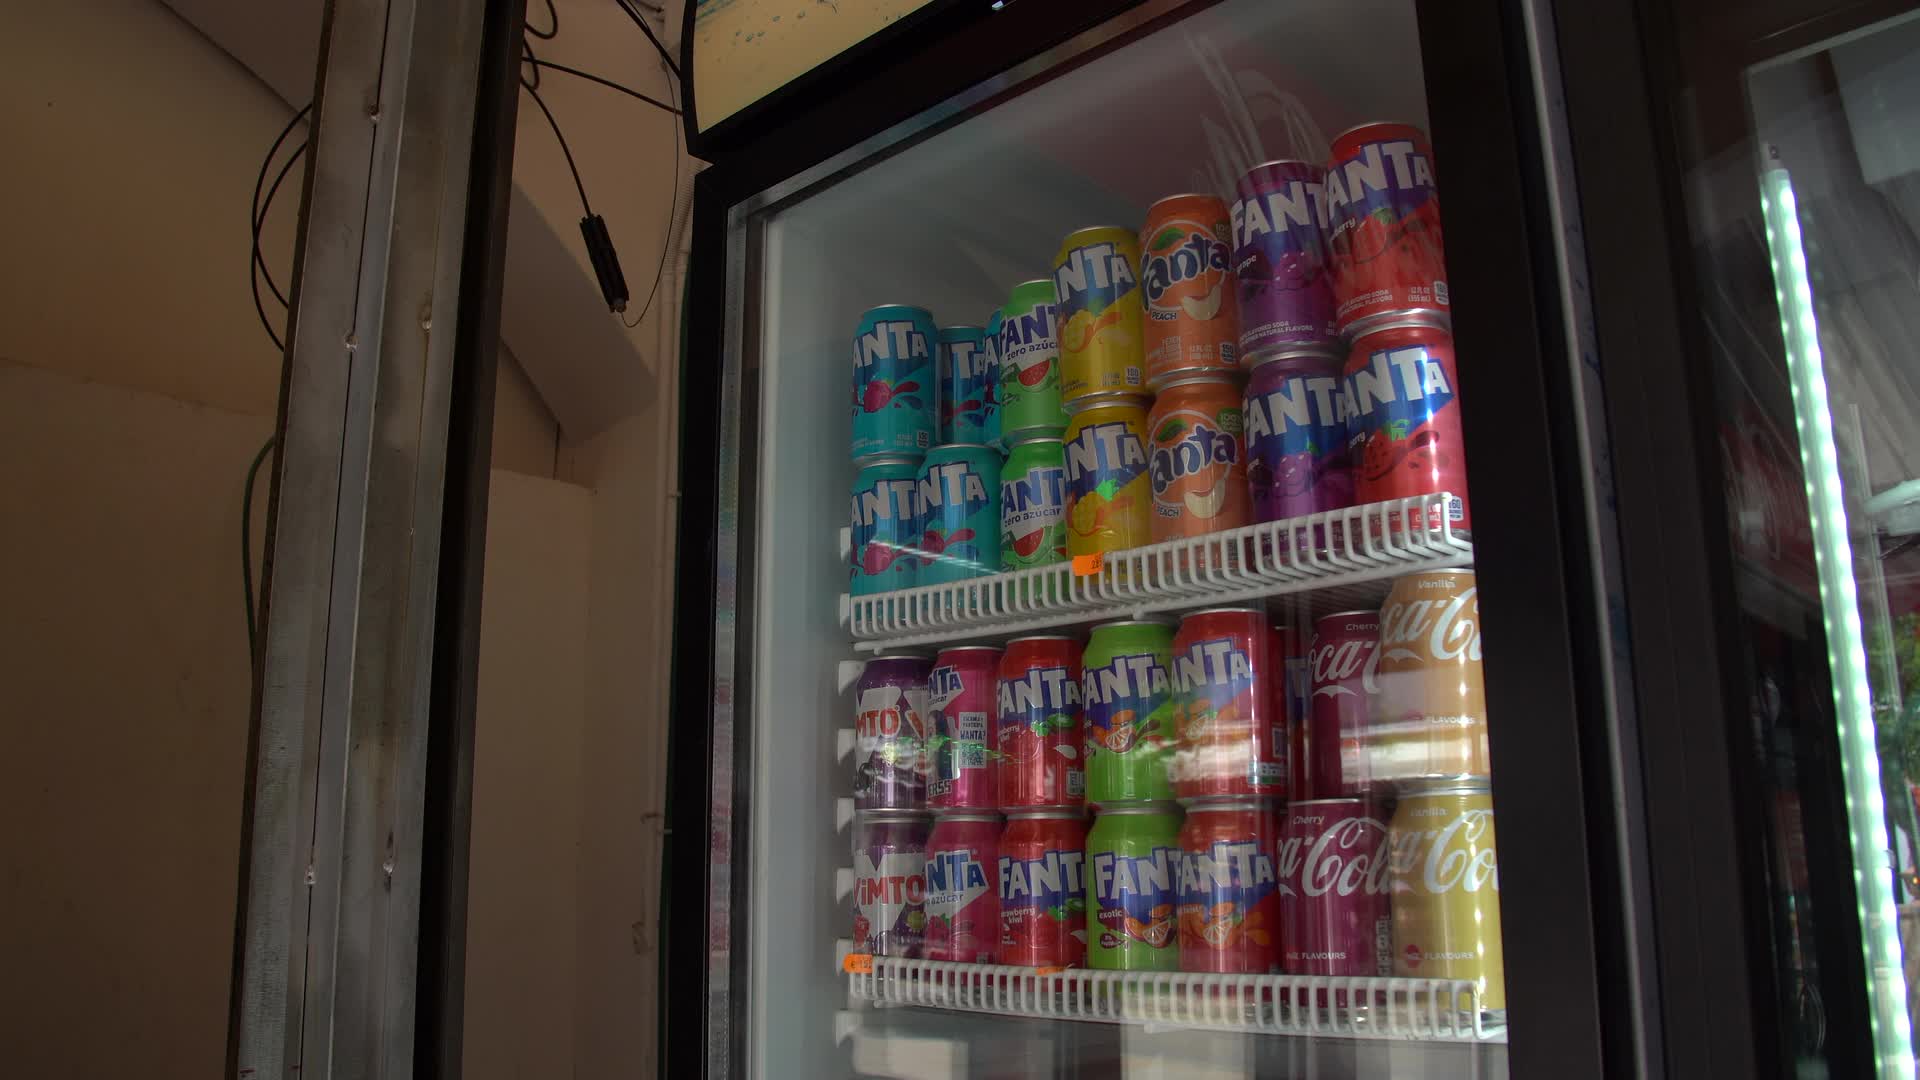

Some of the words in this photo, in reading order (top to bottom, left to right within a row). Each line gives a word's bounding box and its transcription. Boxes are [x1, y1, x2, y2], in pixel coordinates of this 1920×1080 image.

[1328, 141, 1434, 221] ANTA
[1230, 181, 1328, 250] FANT
[1054, 246, 1135, 304] NTA
[1151, 311, 1177, 321] PEACH
[852, 322, 928, 376] ANTA
[1029, 340, 1057, 352] azúc
[1344, 347, 1450, 430] ANTA
[1063, 423, 1146, 481] NTA
[1150, 425, 1237, 495] anta
[851, 481, 918, 526] ANT
[913, 464, 986, 515] NTA
[1001, 469, 1064, 520] ANT
[1418, 579, 1457, 590] Vanilla
[1345, 623, 1379, 632] Cherry
[928, 668, 962, 699] NTA
[1171, 641, 1251, 696] ANTA
[998, 670, 1081, 719] ANTA
[856, 709, 899, 737] MTO
[1293, 815, 1325, 826] Cherry
[927, 853, 986, 893] NTA
[999, 852, 1086, 900] FANT
[1094, 850, 1182, 899] FANT
[1178, 843, 1275, 897] ANTA
[1099, 910, 1122, 919] exotic
[1302, 951, 1346, 960] FLAVOURS
